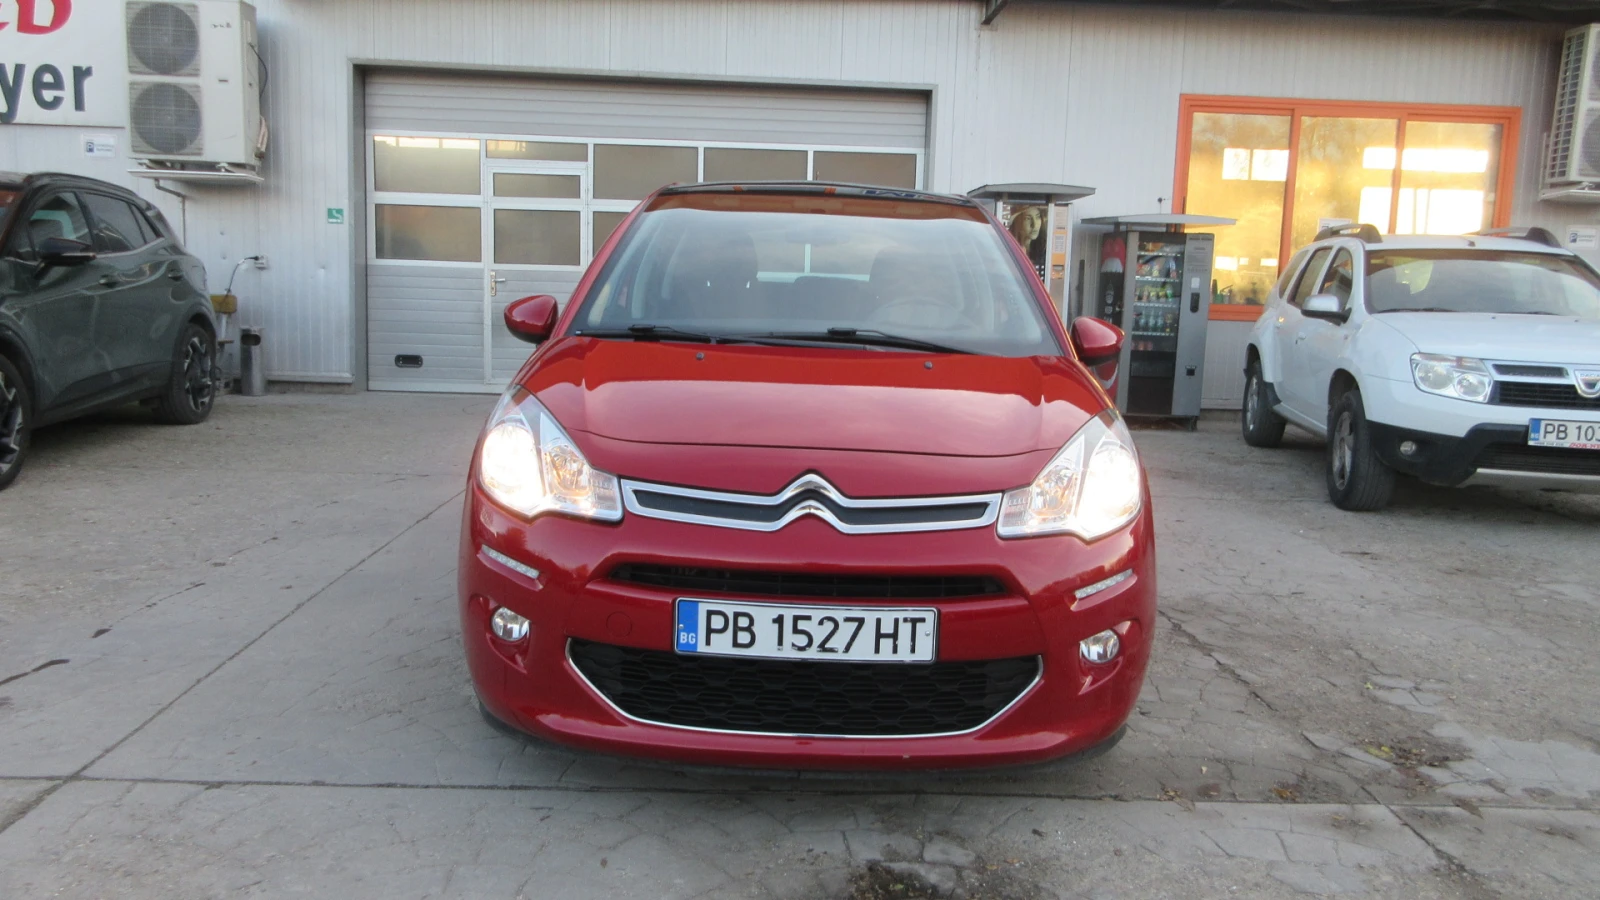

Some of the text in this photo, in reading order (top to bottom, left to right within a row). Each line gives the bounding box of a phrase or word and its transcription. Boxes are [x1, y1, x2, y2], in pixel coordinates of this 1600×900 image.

[0, 63, 94, 124] yer
[1543, 423, 1569, 441] PB
[680, 632, 696, 644] BG
[705, 609, 926, 654] PB 1527 HT
